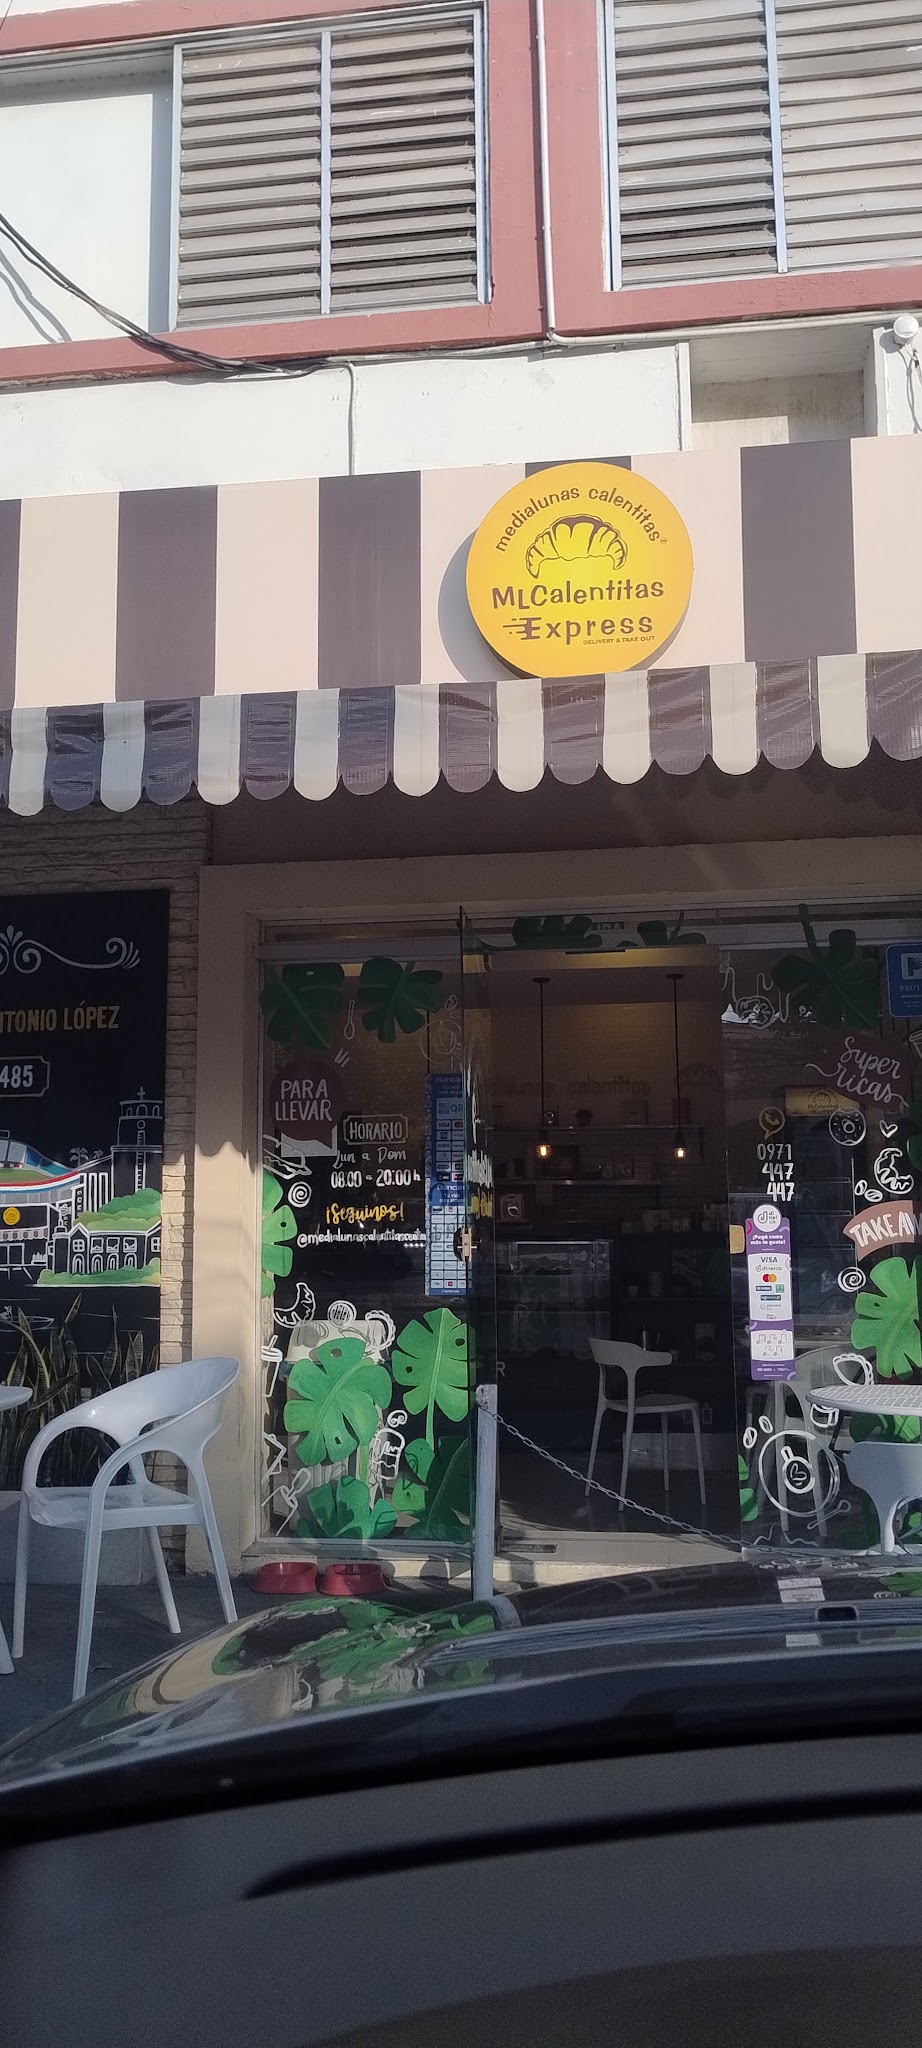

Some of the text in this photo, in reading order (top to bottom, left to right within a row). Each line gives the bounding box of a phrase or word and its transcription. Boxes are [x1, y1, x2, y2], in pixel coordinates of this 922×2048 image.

[495, 487, 660, 552] medialunas calentitas
[492, 579, 665, 610] MLCalentitas
[514, 616, 653, 646] Express
[63, 1000, 121, 1031] LÓPEZ
[839, 1036, 901, 1080] Super
[280, 1078, 329, 1100] PARA
[820, 1062, 907, 1107] ricas
[274, 1099, 333, 1122] LLEVAR
[450, 1104, 464, 1114] QR
[349, 1121, 403, 1142] HORARIO
[332, 1146, 407, 1169] Lun a Dom
[756, 1143, 792, 1162] 0971
[375, 1168, 412, 1187] 20:00
[413, 1168, 422, 1182] h
[762, 1162, 794, 1182] 447
[766, 1182, 795, 1202] 447
[325, 1201, 405, 1225] ¡Seguinos!
[848, 1213, 899, 1248] TAKE
